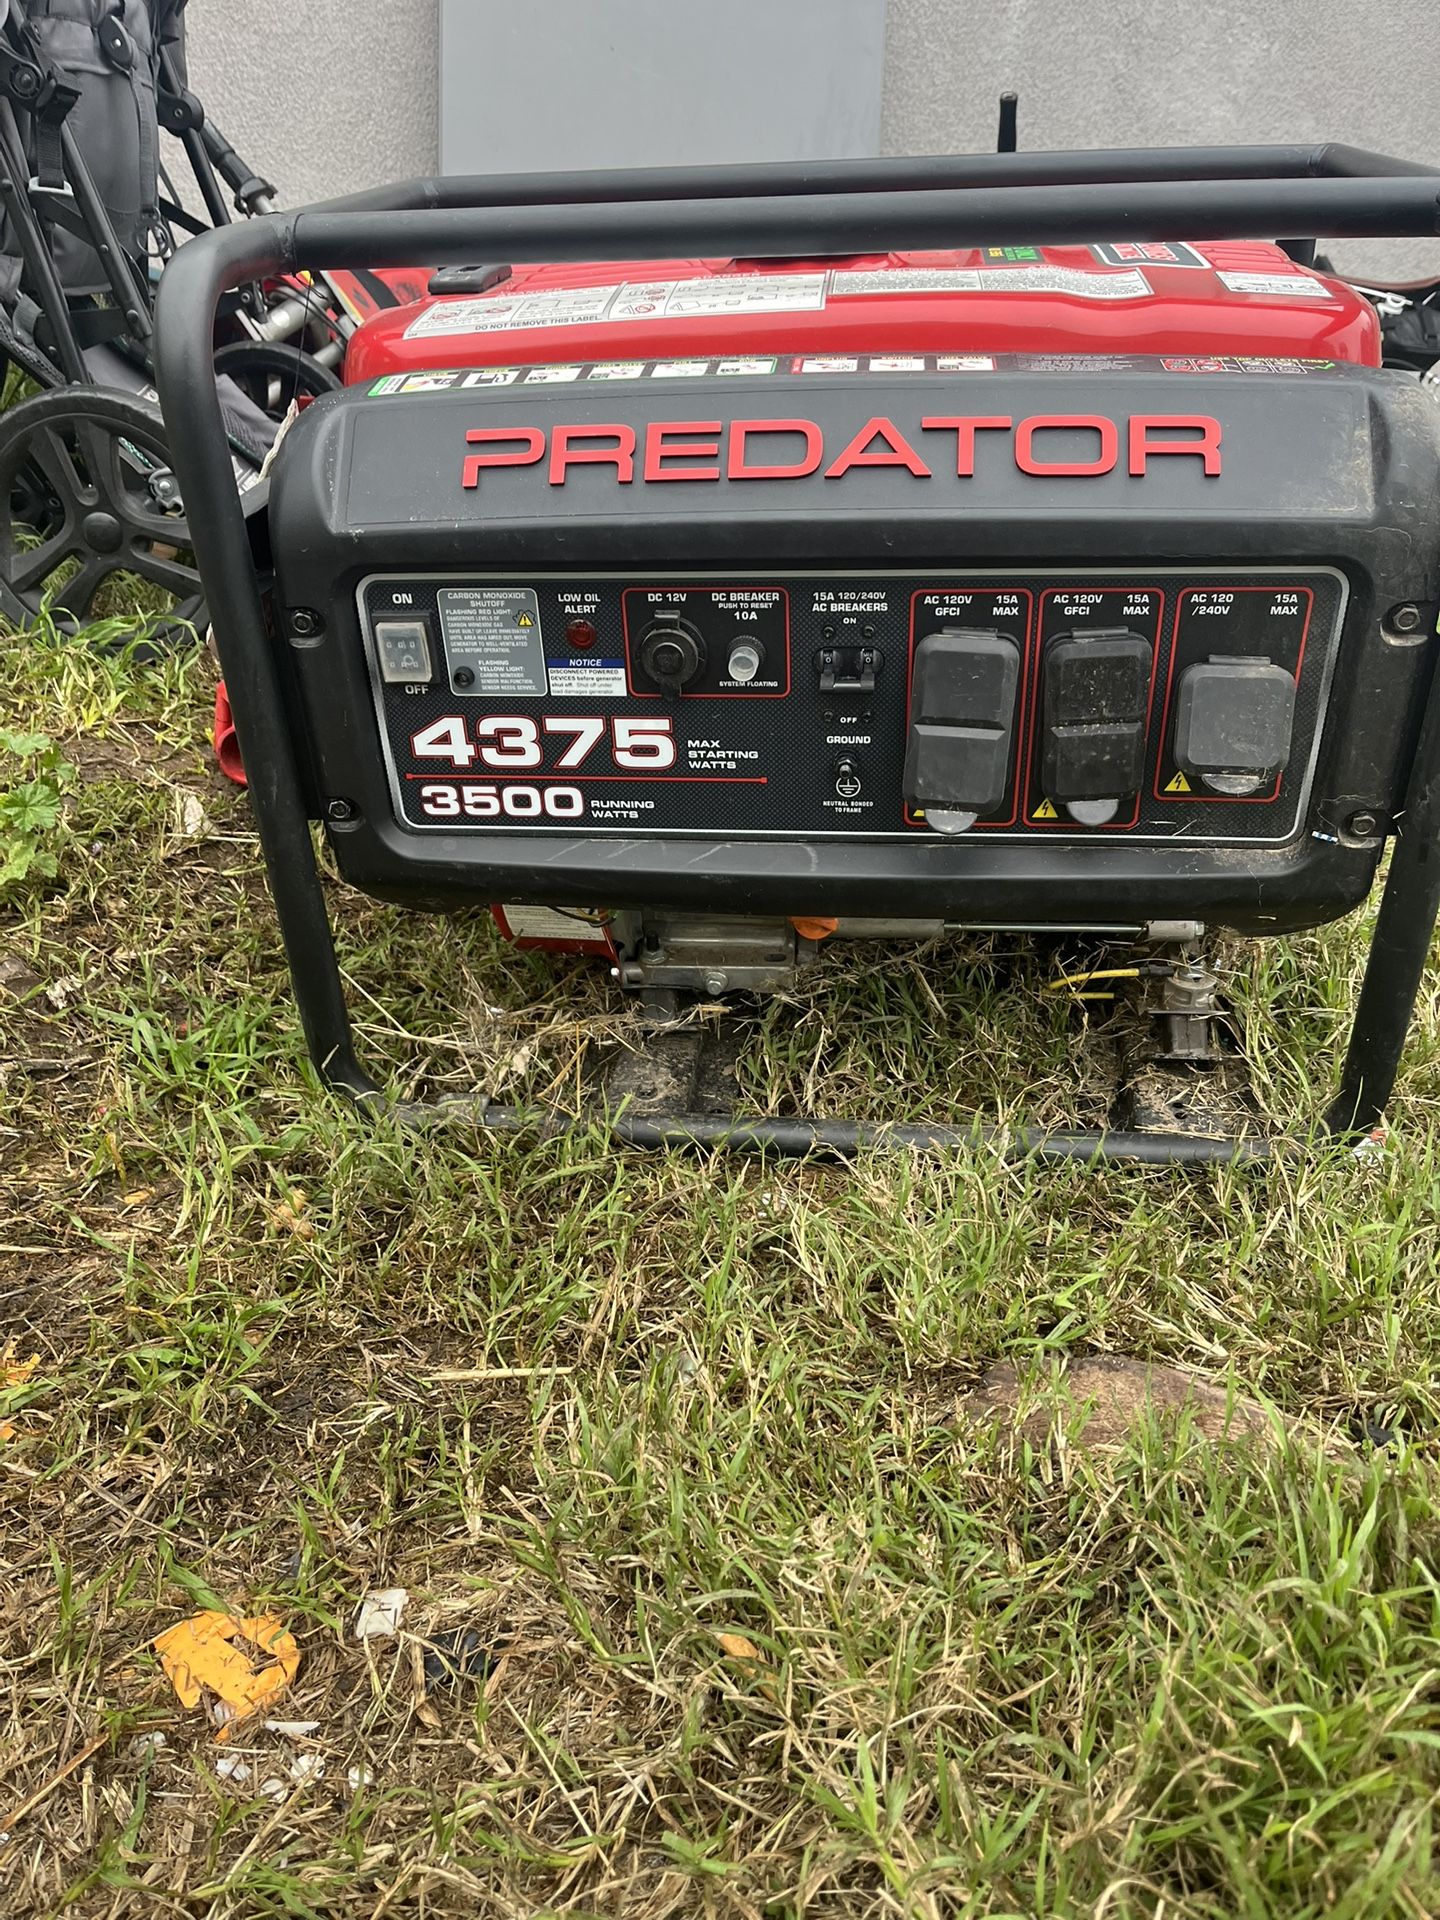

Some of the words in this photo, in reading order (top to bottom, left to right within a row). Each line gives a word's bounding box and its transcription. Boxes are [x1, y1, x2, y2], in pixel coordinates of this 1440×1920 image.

[510, 320, 549, 328] REMOVE
[463, 414, 1223, 488] PREDATOR
[392, 593, 412, 604] ON
[558, 594, 582, 602] LOW
[584, 594, 601, 602] OIL
[648, 594, 664, 602] DC
[666, 594, 686, 602] 12V
[712, 592, 727, 601] DC
[730, 592, 780, 601] BREAKER
[813, 592, 834, 601] 15A
[838, 592, 886, 600] 120/240V
[924, 596, 940, 605] AC
[943, 596, 973, 605] 120V
[996, 594, 1018, 605] 15A
[1053, 594, 1069, 604] AC
[1072, 594, 1103, 604] 120V
[1126, 594, 1149, 604] 15A
[1190, 594, 1208, 604] AC
[1210, 594, 1234, 604] 120
[1274, 594, 1298, 604] 15A
[564, 604, 597, 614] ALERT
[812, 603, 827, 612] AC
[830, 602, 888, 612] BREAKERS
[935, 606, 960, 616] GFCI
[992, 606, 1019, 616] MAX
[1064, 606, 1090, 616] GFCI
[1122, 606, 1150, 616] MAX
[1191, 605, 1230, 616] /240V
[1270, 605, 1298, 616] MAX
[734, 611, 758, 620] 10A
[569, 658, 602, 666] NOTICE
[404, 684, 429, 695] OFF
[410, 713, 678, 771] 4375
[688, 740, 720, 749] MAX
[826, 736, 871, 744] GROUND
[688, 750, 759, 759] STARTING
[689, 760, 737, 770] WATTS
[421, 784, 585, 818] 3500
[591, 800, 655, 810] RUNNING
[592, 810, 639, 820] WATTS
